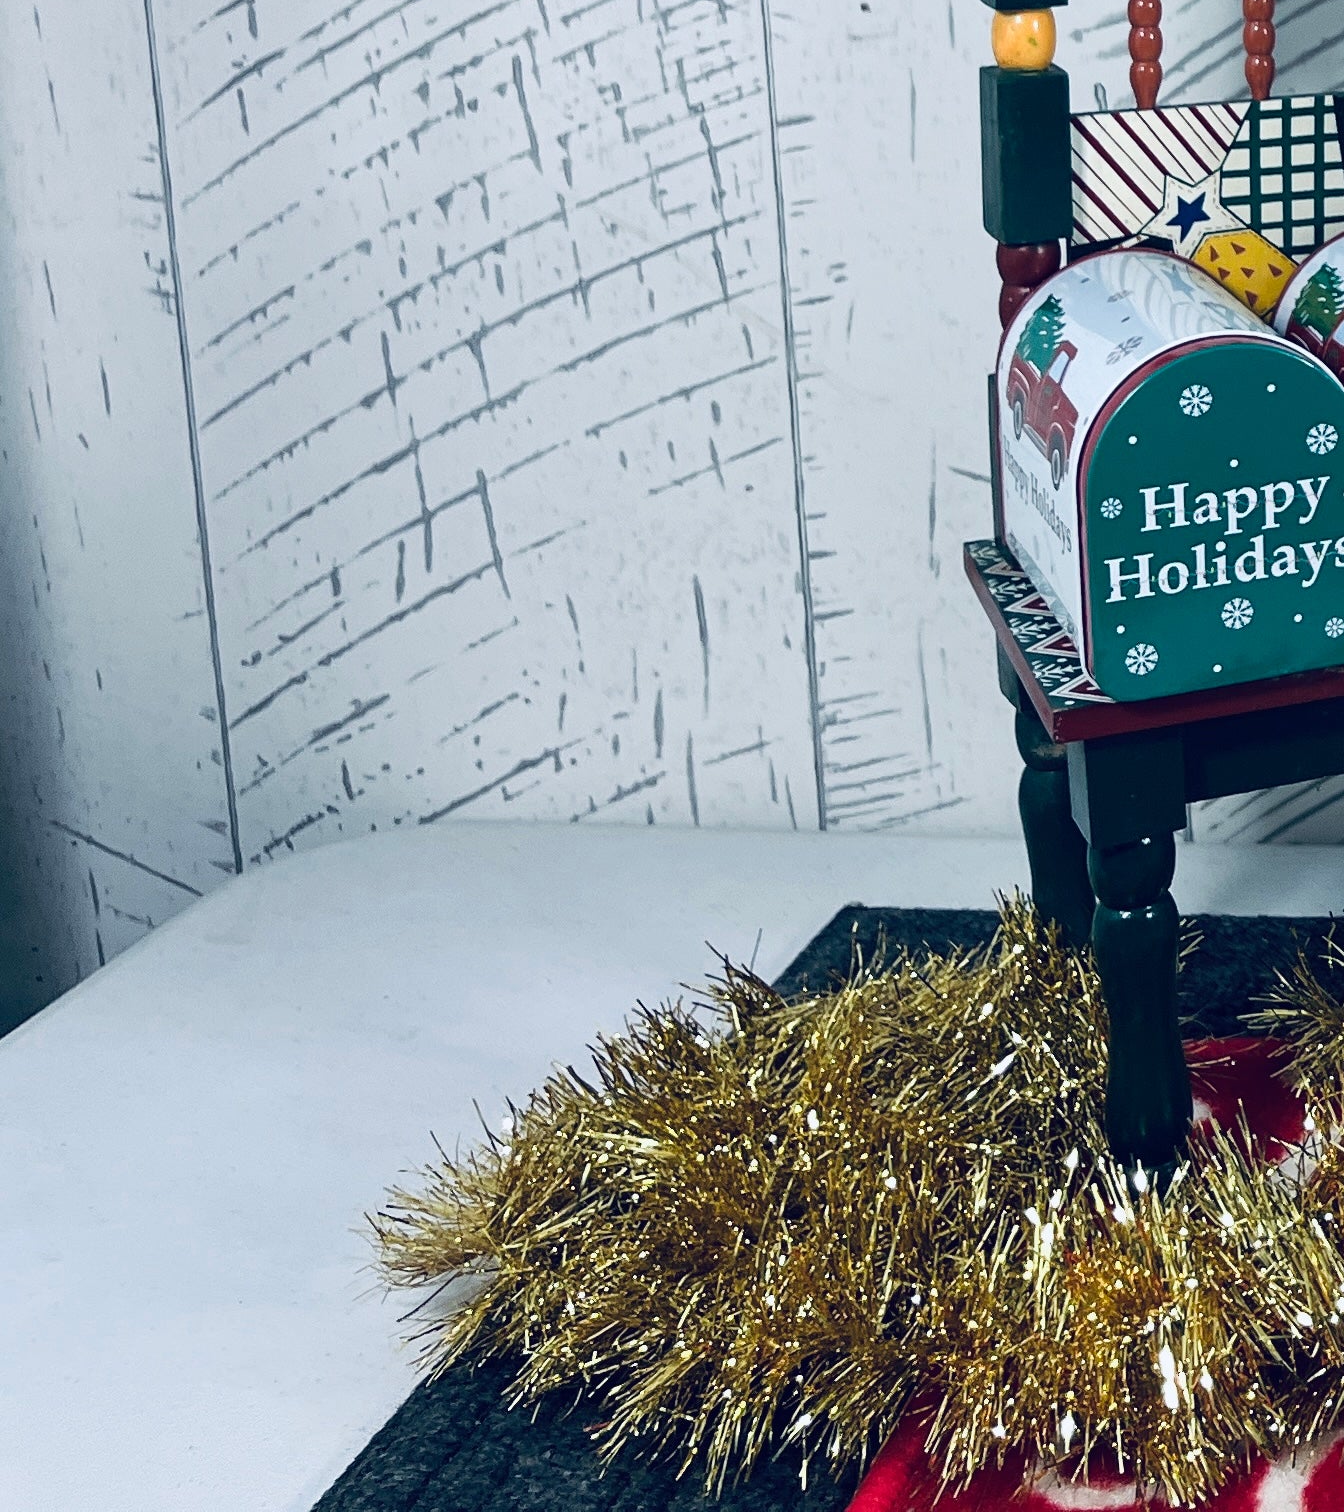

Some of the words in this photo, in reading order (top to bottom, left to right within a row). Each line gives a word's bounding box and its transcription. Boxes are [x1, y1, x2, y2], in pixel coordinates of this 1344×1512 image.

[1002, 434, 1030, 505] Happy
[1030, 471, 1072, 555] Holidays
[1138, 475, 1331, 536] Happy
